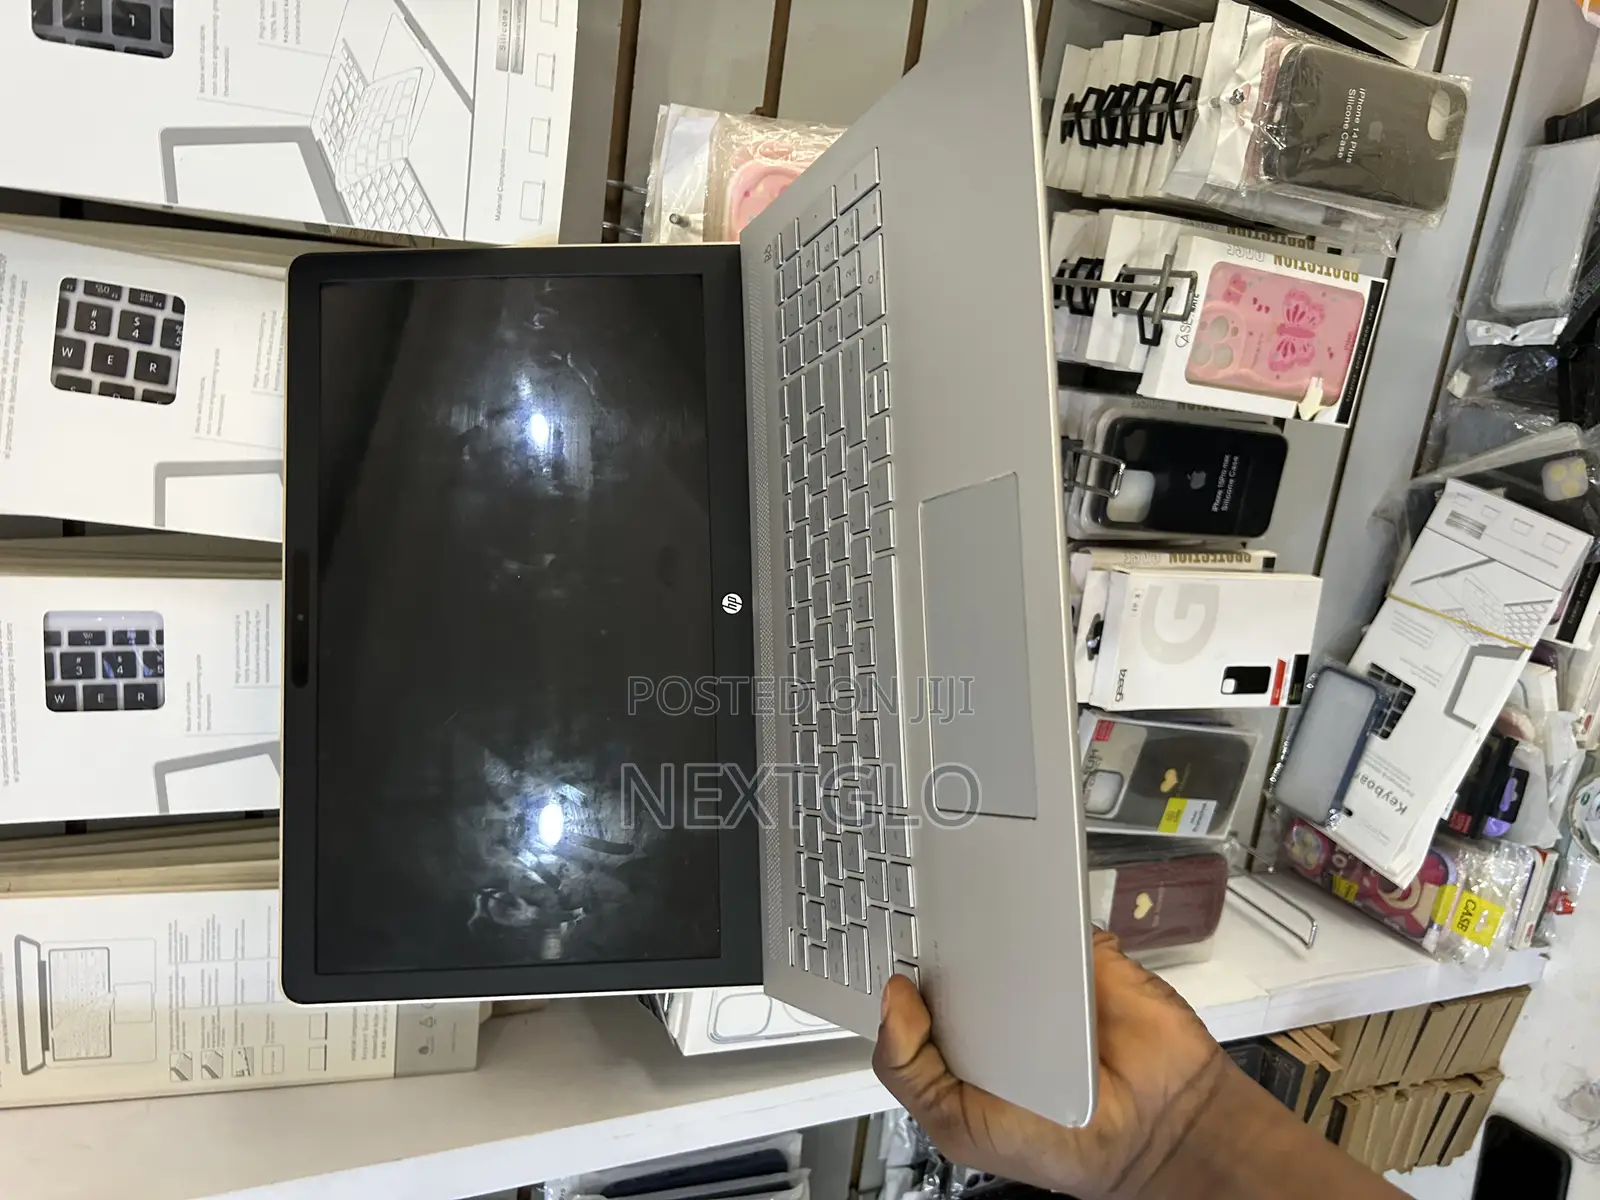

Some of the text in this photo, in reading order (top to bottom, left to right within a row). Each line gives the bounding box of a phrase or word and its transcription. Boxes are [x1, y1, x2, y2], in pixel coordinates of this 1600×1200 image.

[499, 8, 509, 52] Silicone
[1336, 88, 1357, 159] Silicone Case
[1345, 87, 1366, 164] iPhone 14 Plus
[494, 148, 507, 221] Material Composition
[1221, 455, 1239, 511] Silicone Case
[721, 593, 743, 614] hp
[1114, 669, 1128, 702] gear4
[1353, 771, 1408, 816] Keyboar
[1457, 899, 1477, 932] CASE
